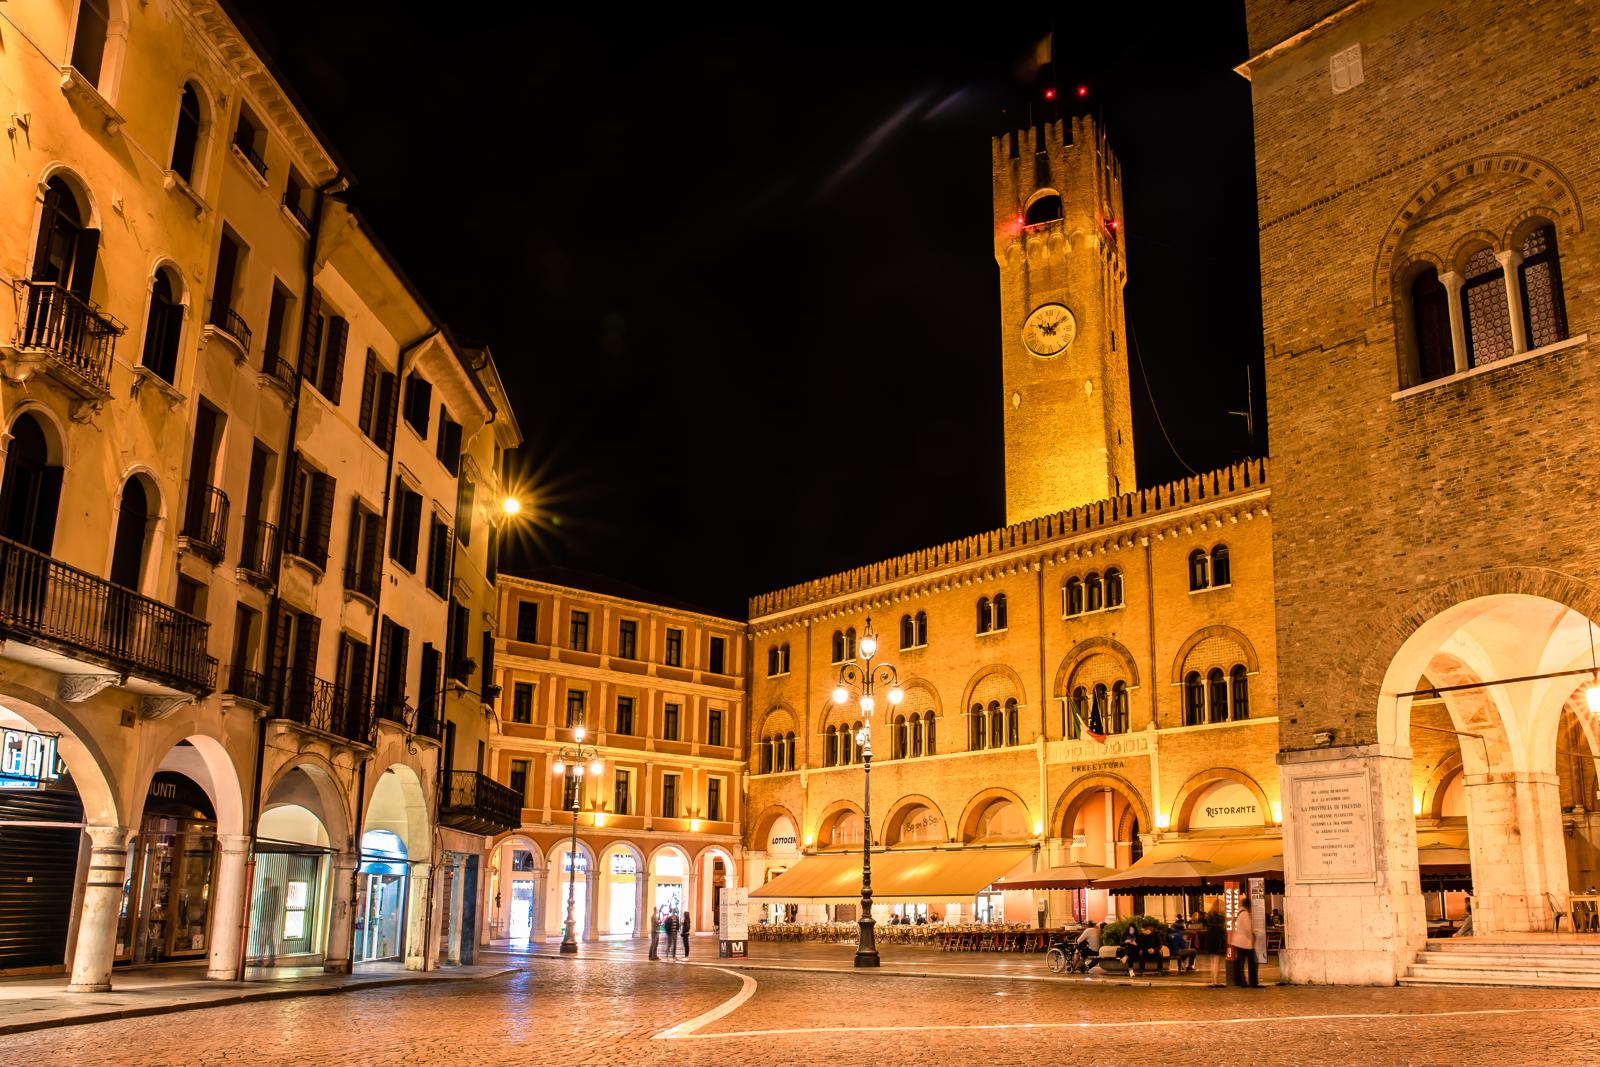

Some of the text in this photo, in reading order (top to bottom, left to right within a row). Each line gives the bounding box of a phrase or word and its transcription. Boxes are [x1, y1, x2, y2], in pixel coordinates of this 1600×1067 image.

[1071, 760, 1124, 773] PREFETTURA
[1205, 805, 1256, 818] RISTORANTE
[731, 941, 744, 952] M
